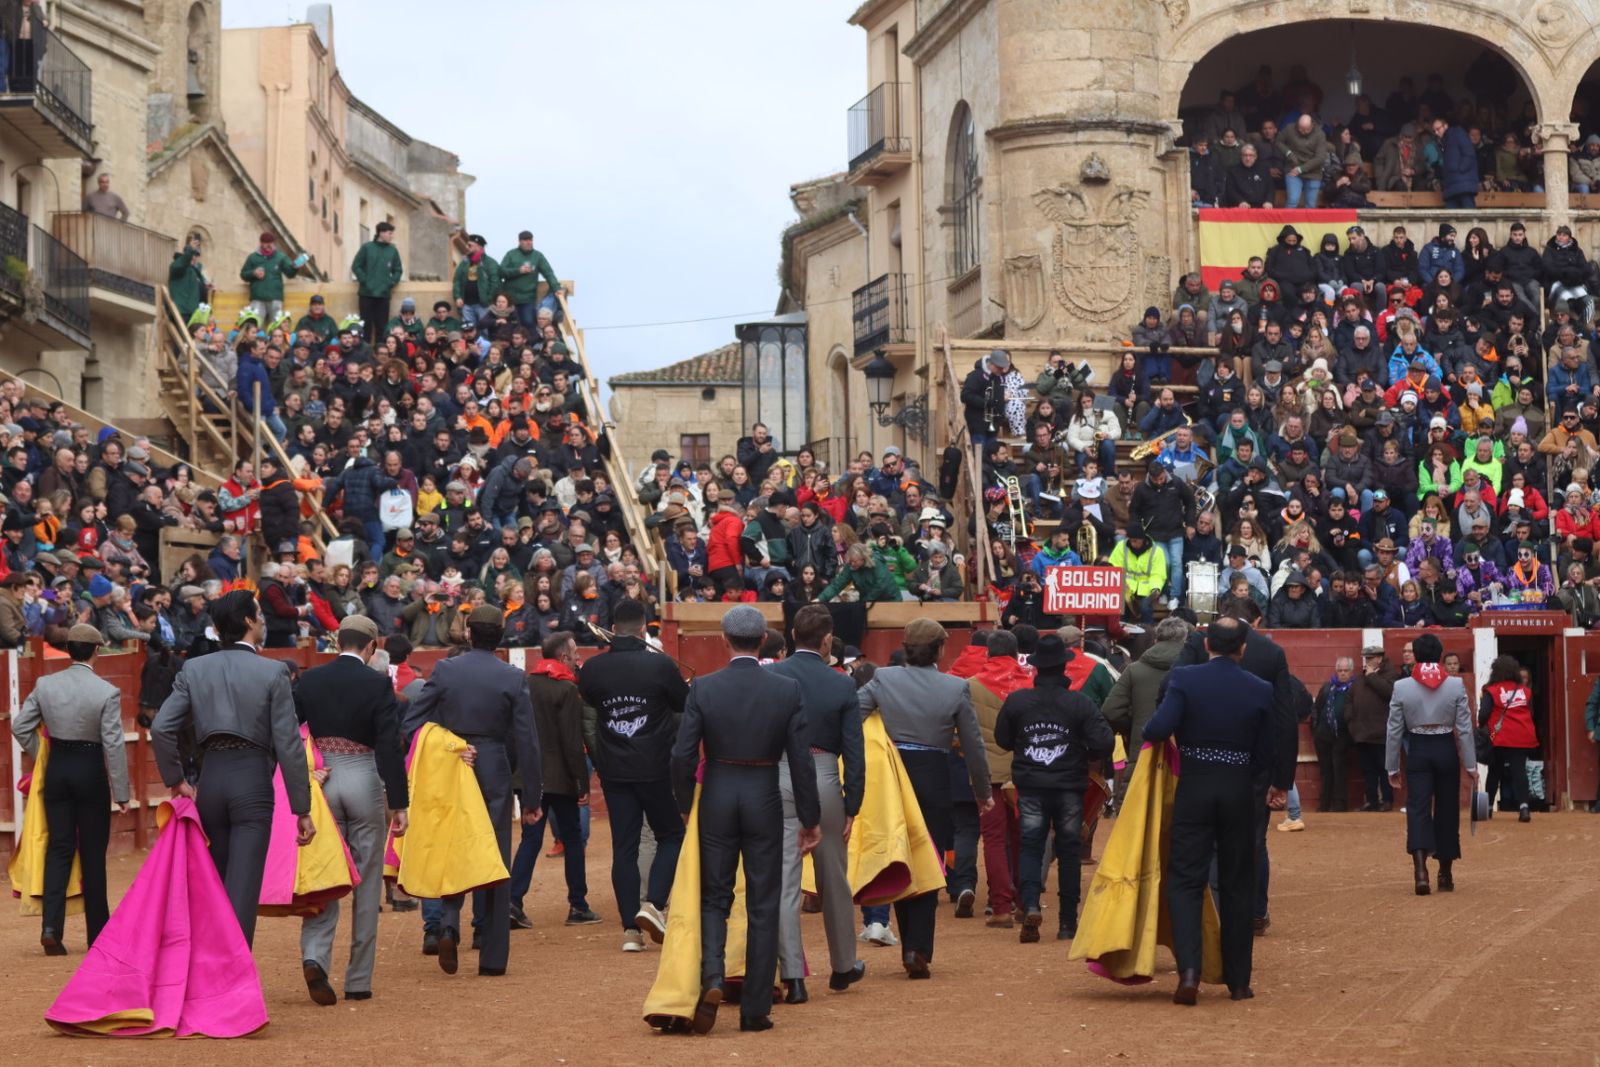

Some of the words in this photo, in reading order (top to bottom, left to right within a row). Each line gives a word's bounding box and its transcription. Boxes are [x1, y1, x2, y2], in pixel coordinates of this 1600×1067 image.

[1061, 570, 1121, 587] BOLSIN
[1056, 592, 1120, 609] TAURINO
[1490, 619, 1554, 627] ENFERMERIA
[602, 695, 647, 707] CHARANGA
[1023, 722, 1070, 734] CHARANGA
